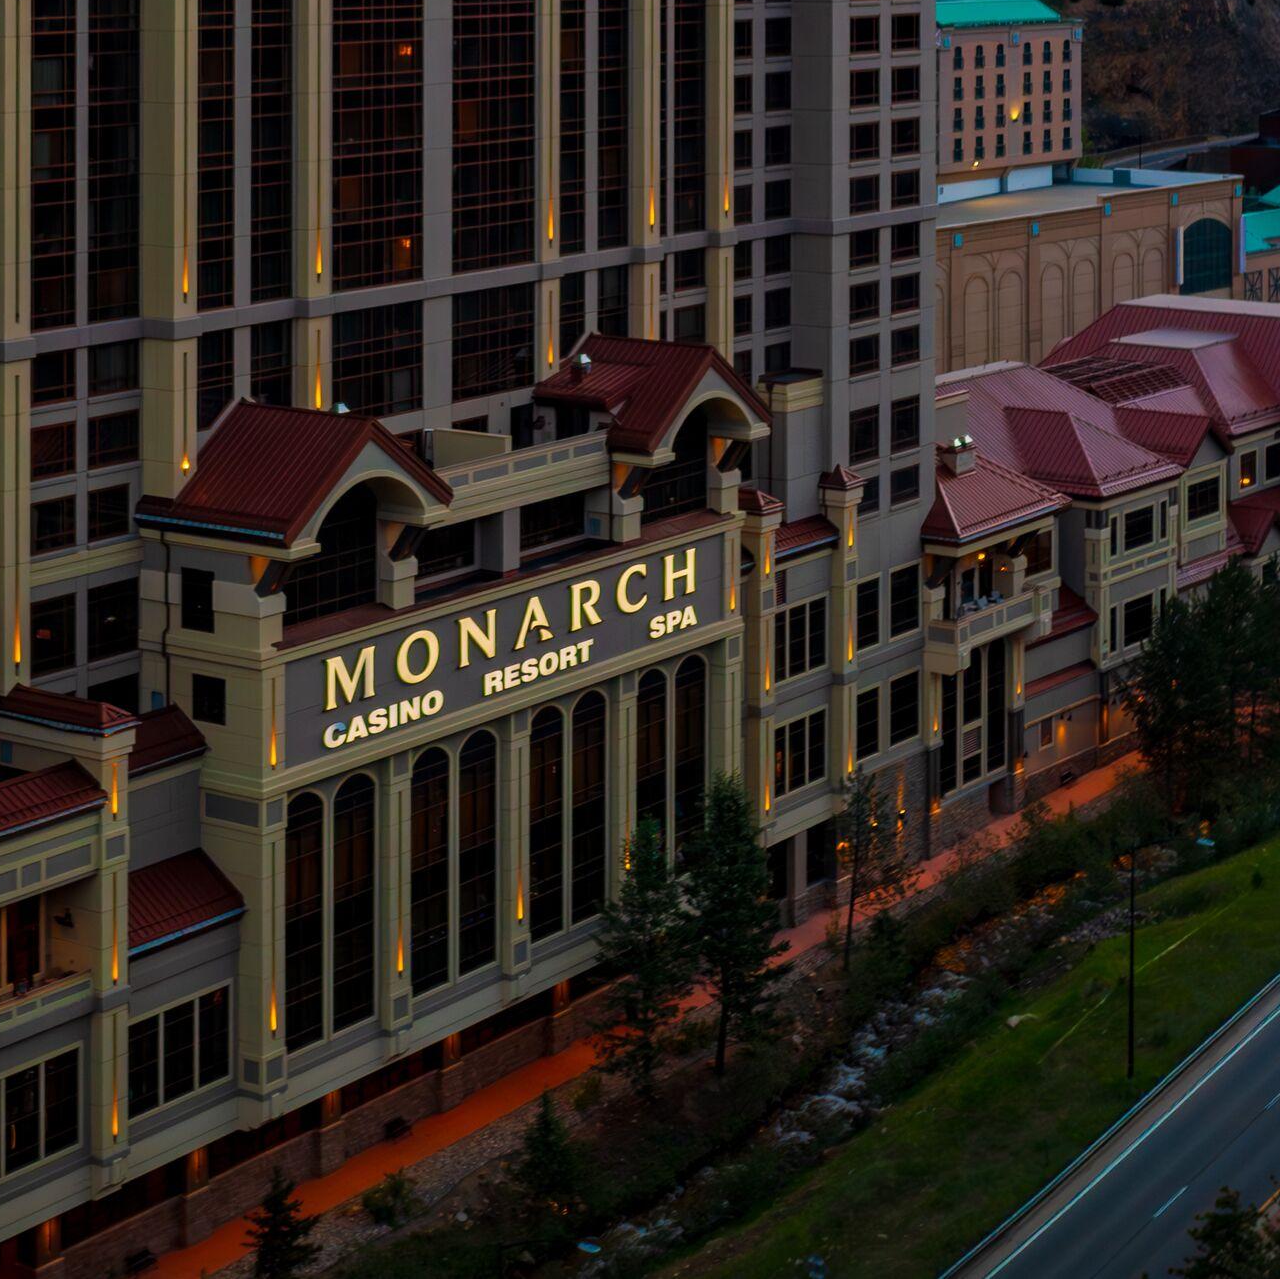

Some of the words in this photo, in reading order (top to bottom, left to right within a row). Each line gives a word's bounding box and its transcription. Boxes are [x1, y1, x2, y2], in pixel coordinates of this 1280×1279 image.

[322, 547, 697, 712] MONARCH
[323, 689, 444, 749] CASINO
[483, 638, 595, 696] RESORT
[649, 605, 697, 639] SPA
